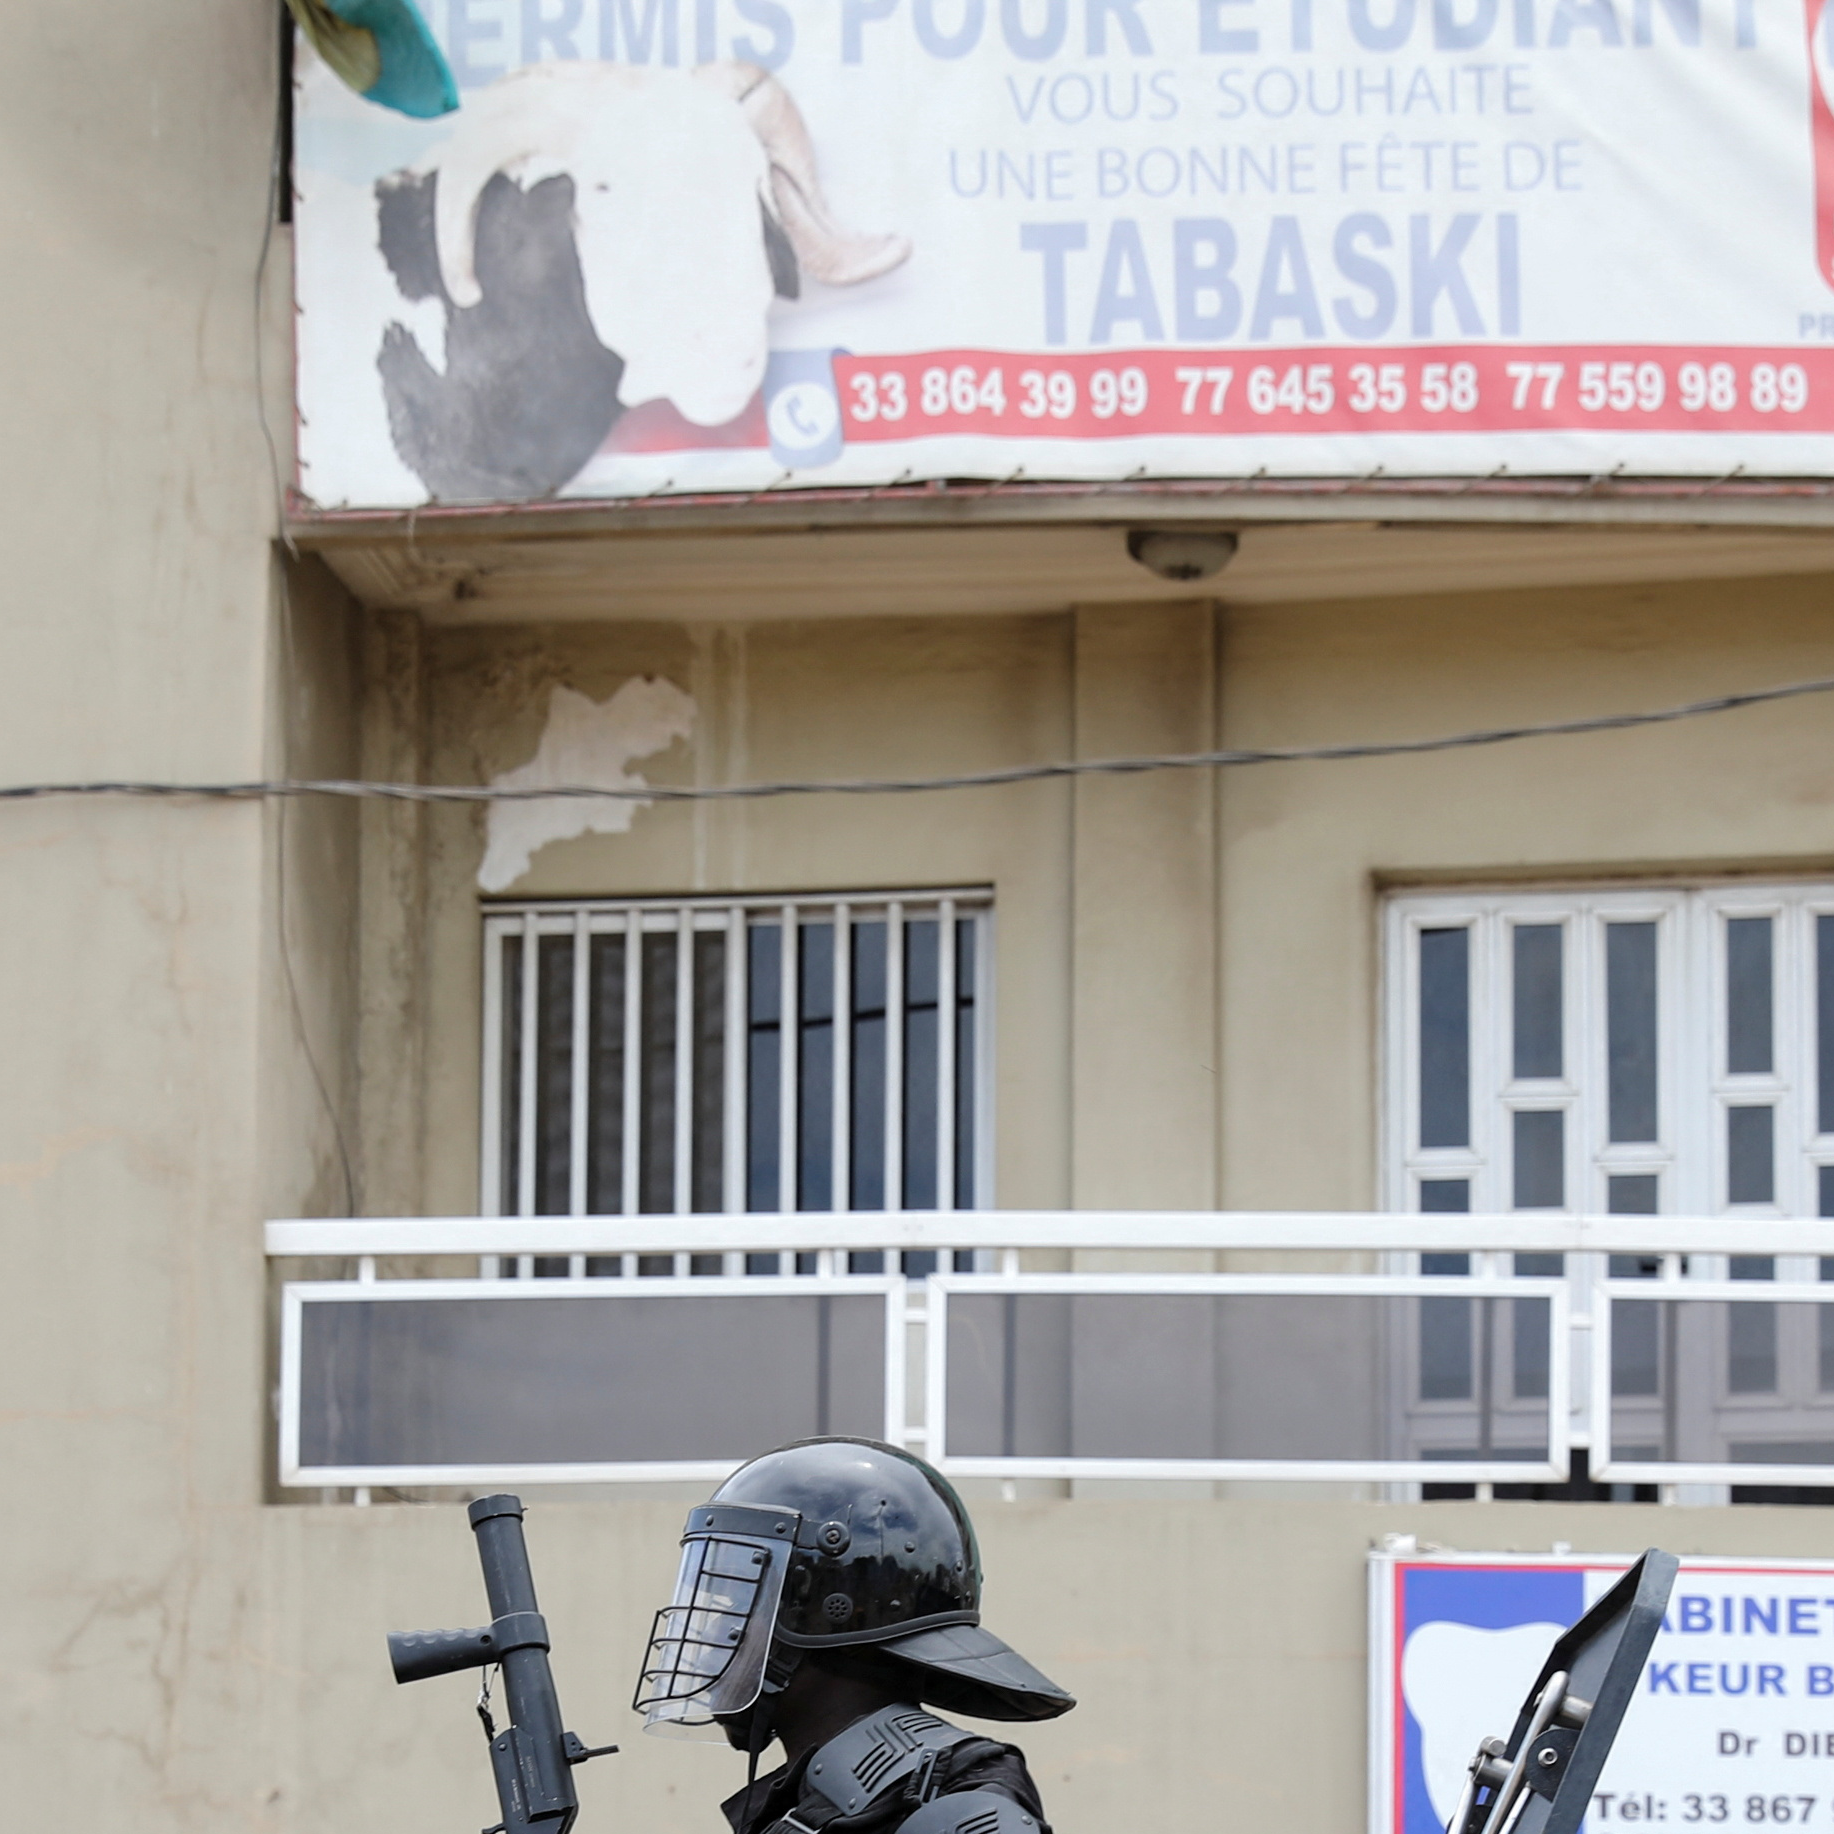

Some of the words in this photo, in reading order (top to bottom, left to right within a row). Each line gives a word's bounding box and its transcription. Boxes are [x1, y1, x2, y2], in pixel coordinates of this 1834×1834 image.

[425, 0, 796, 90] ERMIS
[1005, 70, 1179, 125] VOUS
[1217, 64, 1535, 119] SOUHAITE
[949, 148, 1074, 201] UNE
[1097, 144, 1317, 198] BONNE
[1339, 132, 1480, 193] FÊTE
[1503, 140, 1585, 191] DE
[1020, 211, 1521, 346] TABASKI
[851, 372, 908, 422] 33
[920, 368, 1007, 418] 864
[1019, 370, 1077, 418] 39
[1090, 368, 1148, 418] 99
[1176, 366, 1234, 415] 77
[1248, 365, 1335, 415] 645
[1349, 364, 1407, 413] 35
[1420, 362, 1478, 412] 58
[1506, 361, 1564, 410] 77
[1578, 362, 1665, 412] 559
[1679, 363, 1737, 412] 98
[1750, 364, 1809, 413] 89
[1649, 1662, 1786, 1696] KEUR
[1718, 1730, 1758, 1757] Dr
[1593, 1791, 1666, 1821] Tél:
[1683, 1794, 1729, 1822] 33
[1746, 1795, 1817, 1823] 867
